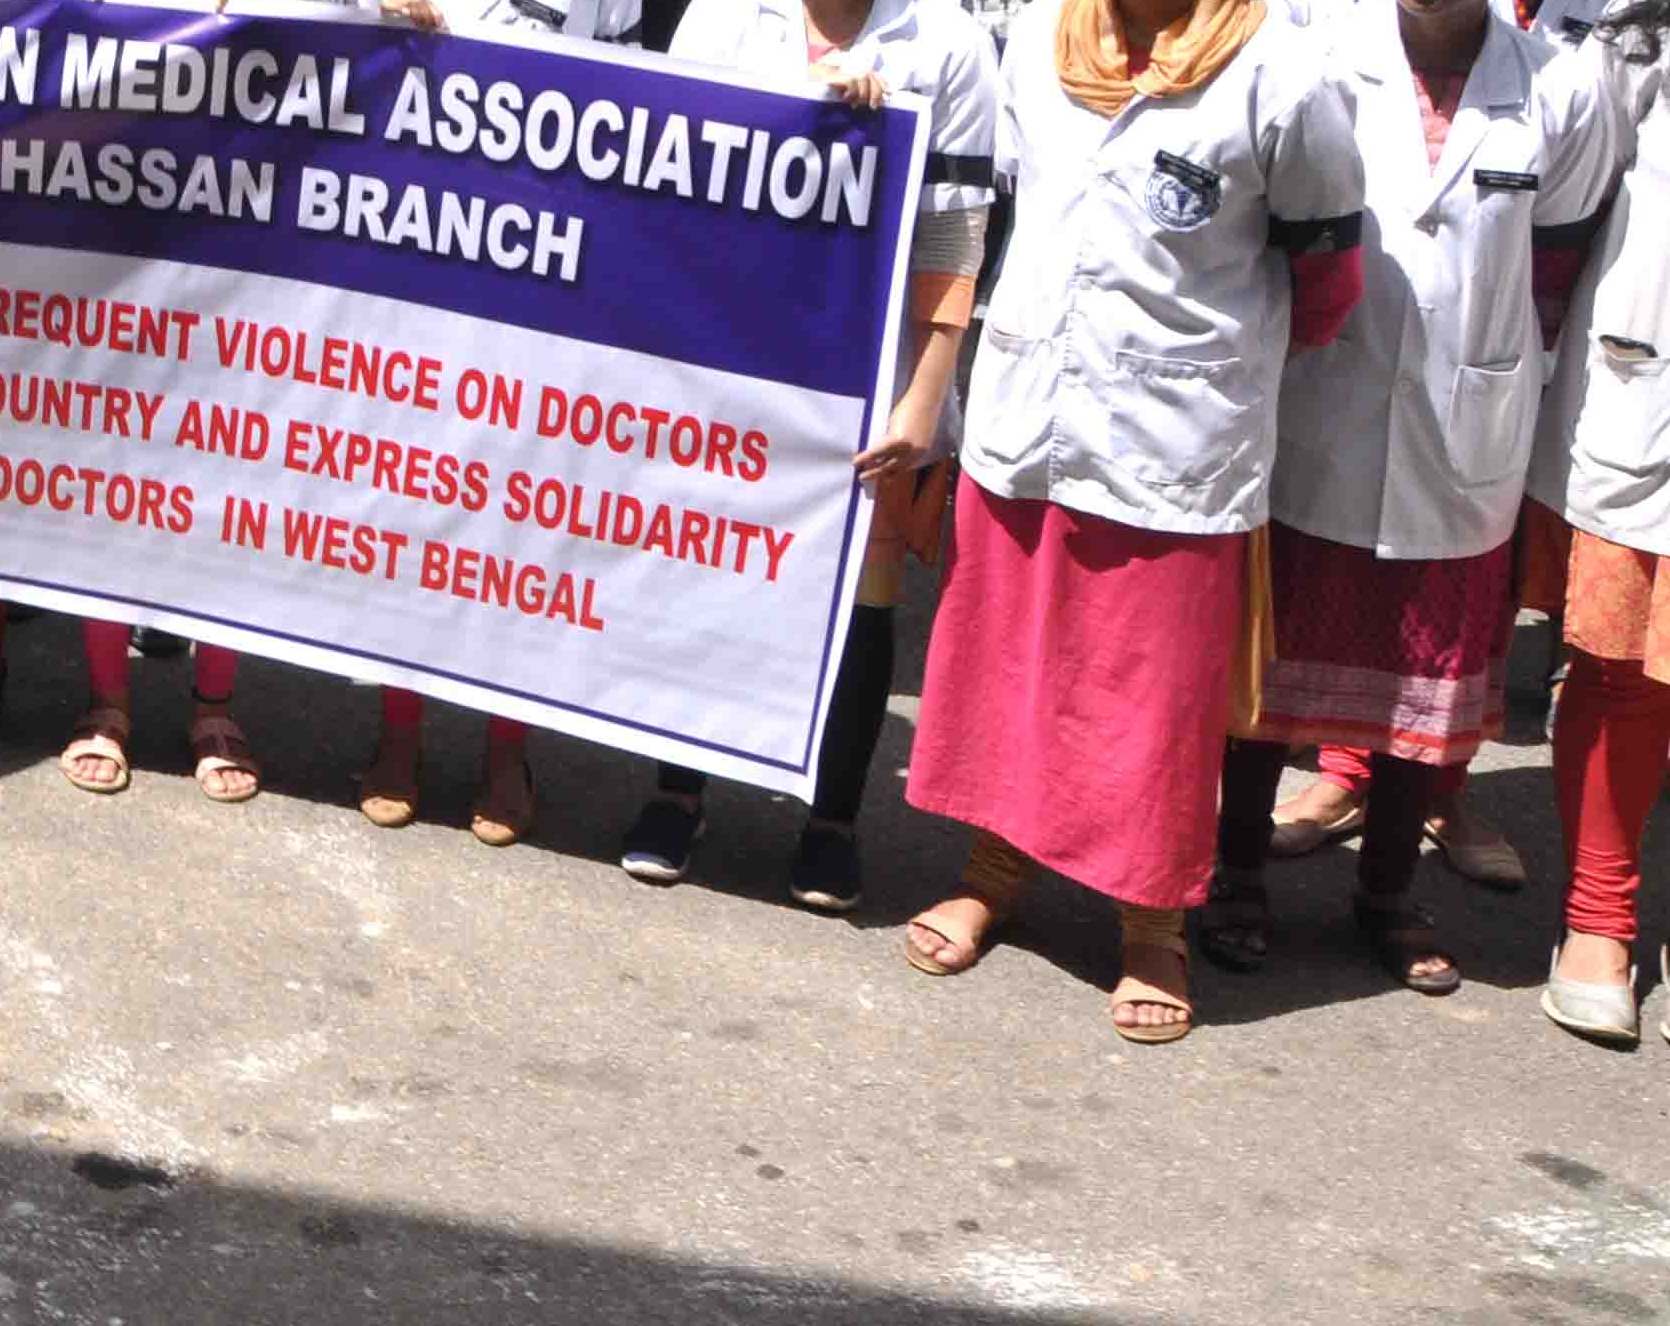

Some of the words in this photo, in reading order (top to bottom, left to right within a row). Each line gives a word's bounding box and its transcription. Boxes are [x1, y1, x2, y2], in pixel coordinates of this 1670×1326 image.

[0, 138, 276, 223] HASSAN
[297, 167, 585, 283] BRANCH
[60, 33, 366, 136] MEDICAL
[385, 65, 879, 228] ASSOCIATION
[215, 316, 444, 411] VIOLENCE
[455, 368, 523, 431] ON
[537, 385, 770, 484] DOCTORS
[175, 400, 271, 463] AND
[283, 419, 491, 513] EXPRESS
[503, 469, 796, 582] SOLIDARITY
[220, 495, 270, 551] IN
[283, 507, 409, 581] WEST
[419, 540, 606, 633] BENGAL
